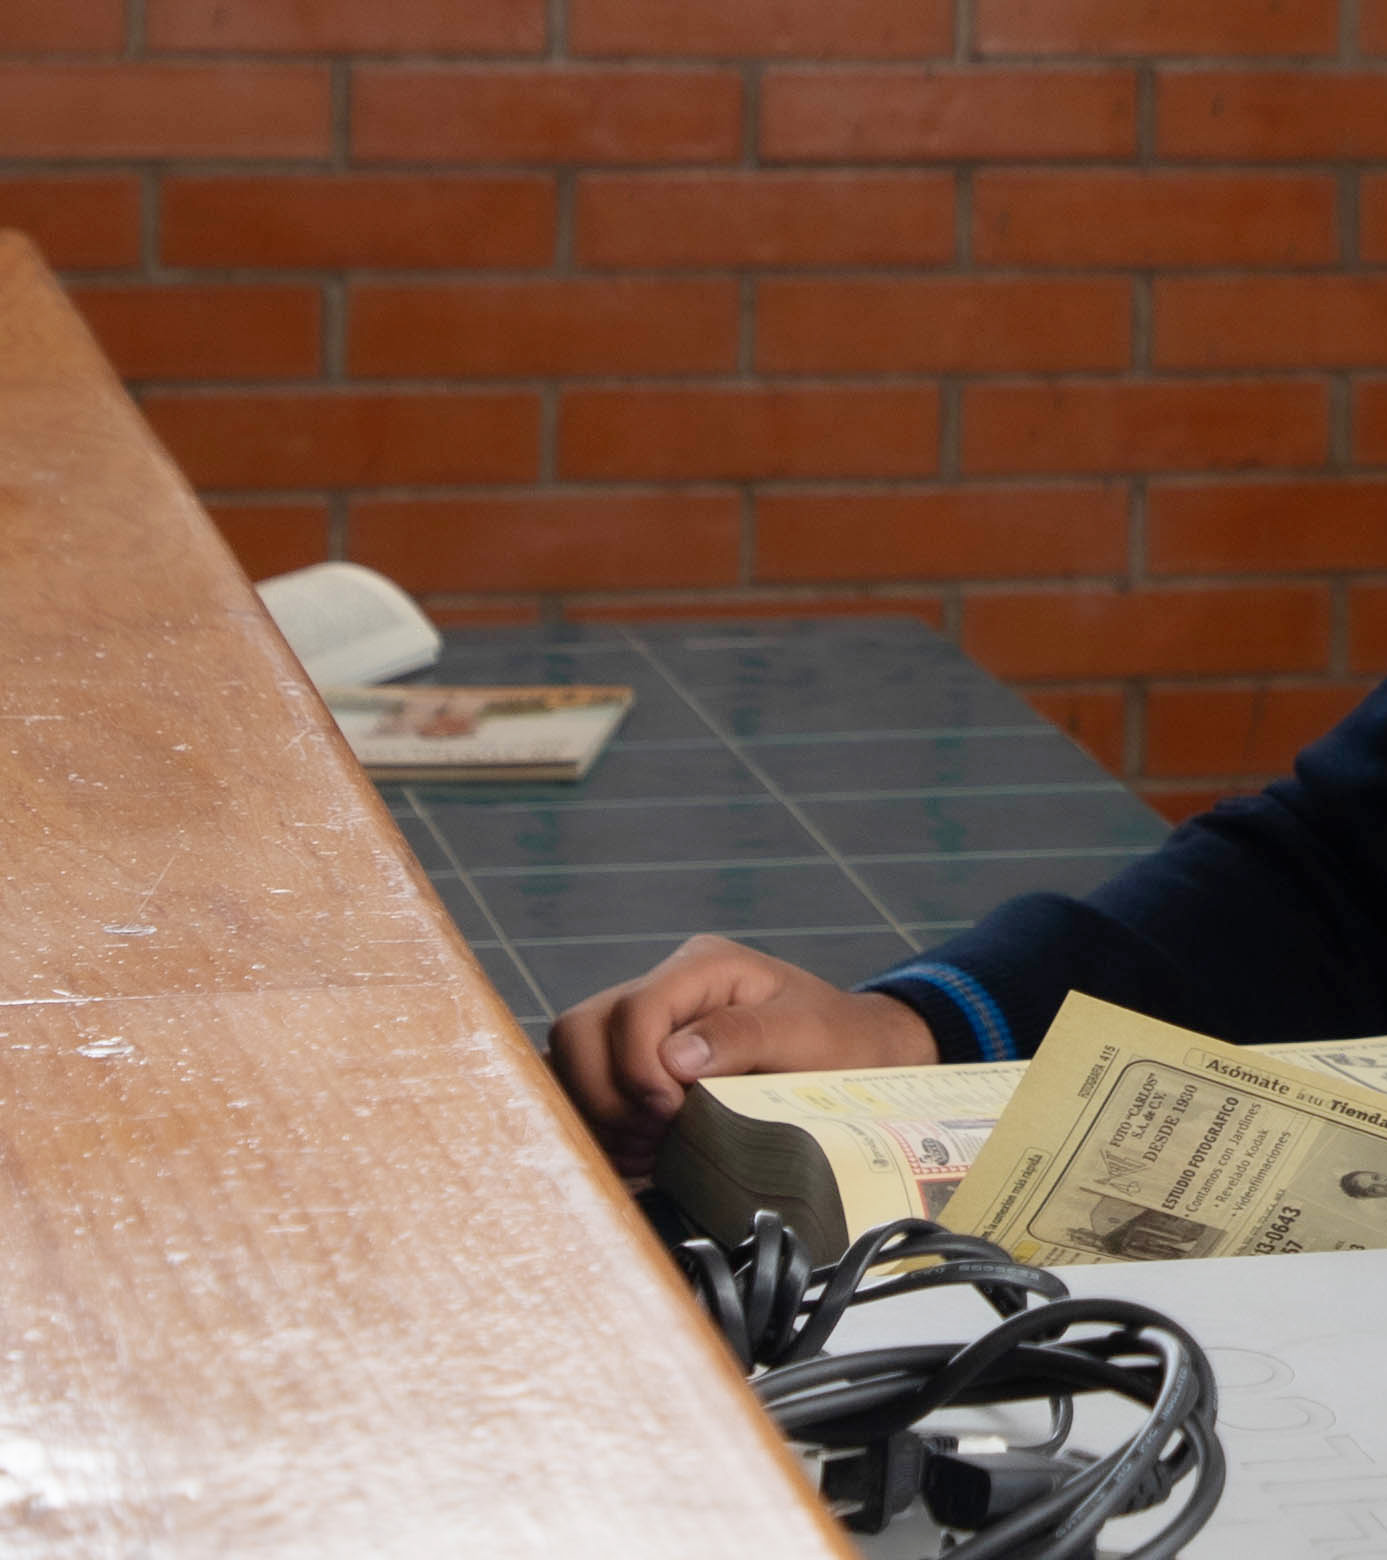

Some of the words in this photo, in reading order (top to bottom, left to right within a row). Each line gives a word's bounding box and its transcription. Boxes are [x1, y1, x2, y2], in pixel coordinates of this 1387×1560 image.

[1142, 1115, 1181, 1163] DESDE
[1172, 1083, 1199, 1115] 1930
[1205, 1058, 1291, 1096] Asómate
[1306, 1093, 1324, 1108] tu
[1109, 1121, 1133, 1148] FOTO
[1161, 1168, 1196, 1211] ESTUDIO
[1187, 1096, 1240, 1170] FOTOGRAFICO
[1184, 1166, 1224, 1213] Contamos
[1217, 1146, 1235, 1167] con
[1228, 1102, 1262, 1146] Jardines
[1215, 1159, 1251, 1203] Revelado
[1244, 1129, 1270, 1159] Kodak
[1232, 1130, 1292, 1212] Videofilmaciones
